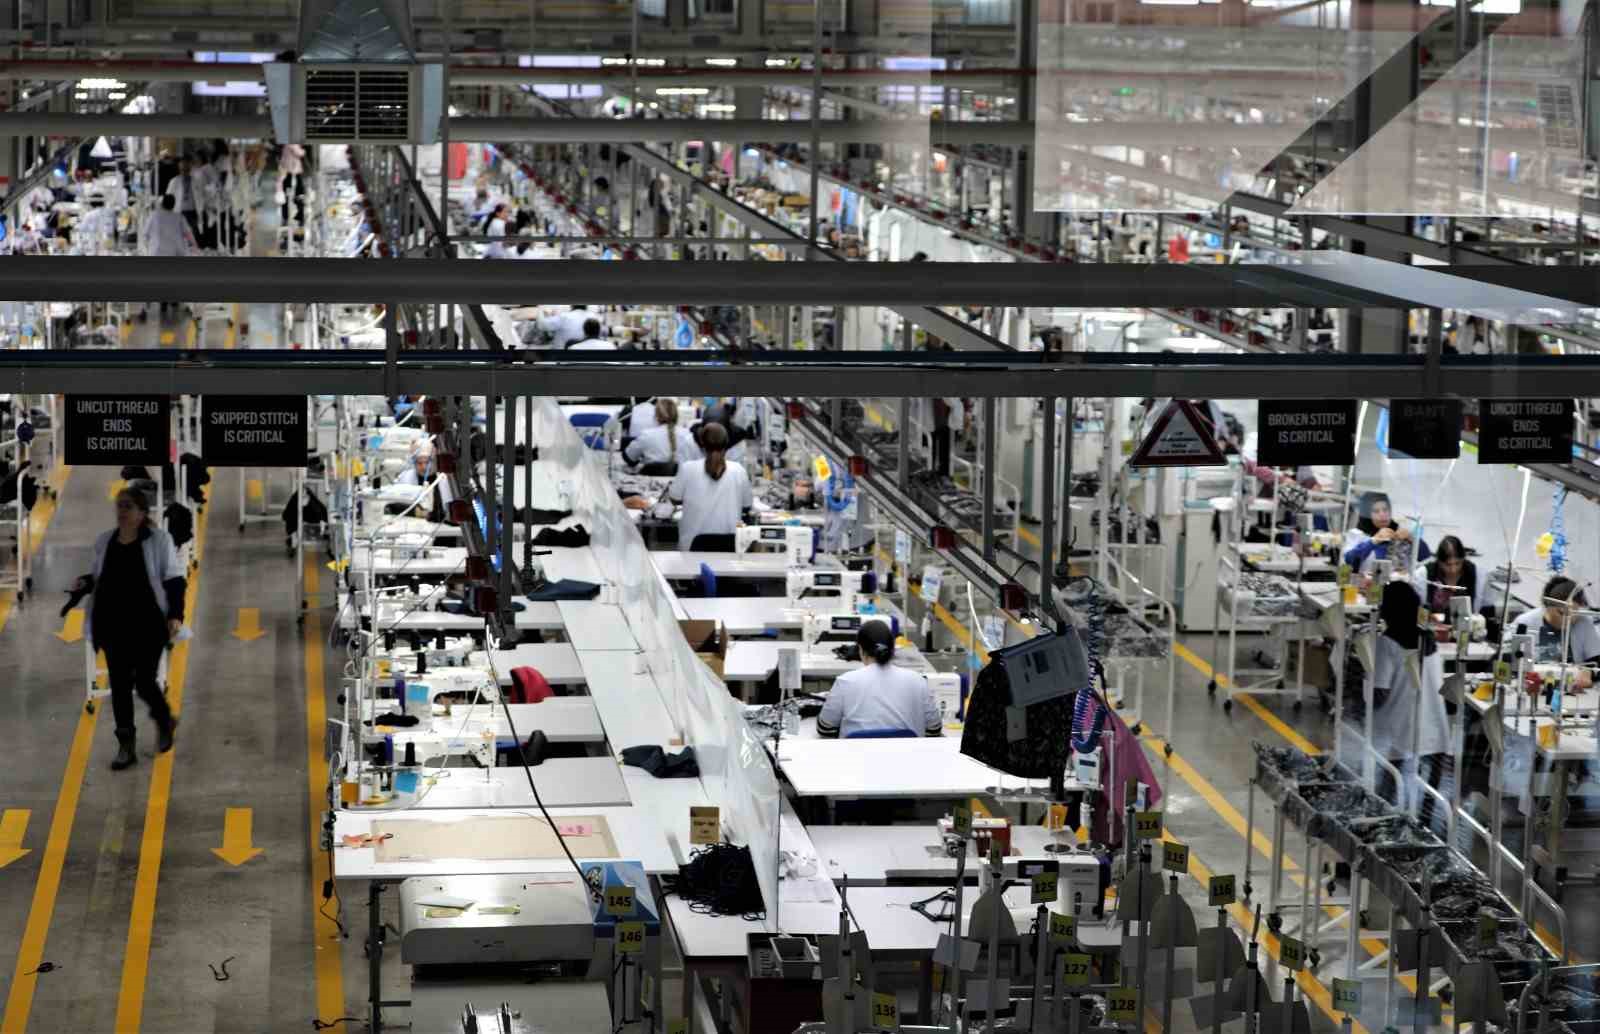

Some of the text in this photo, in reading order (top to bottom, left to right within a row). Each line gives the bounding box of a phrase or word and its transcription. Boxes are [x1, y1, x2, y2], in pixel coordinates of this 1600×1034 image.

[77, 400, 158, 414] UNCUT THREAD
[1490, 402, 1563, 415] UNCUT THREAD
[210, 411, 299, 425] SKIPPED STITCH
[1268, 412, 1346, 426] BROKEN STITCH
[103, 419, 132, 432] ENDS
[1513, 420, 1540, 432] ENDS
[224, 430, 286, 443] IS CRITICAL
[1278, 430, 1334, 443] IS CRITICAL
[1498, 437, 1552, 449] IS CRITICAL
[87, 437, 148, 450] IS CRITICAL
[1035, 881, 1055, 893] 125
[608, 896, 632, 906] 145
[619, 929, 642, 943] 146
[1063, 963, 1088, 974] 127
[1110, 999, 1136, 1011] 128
